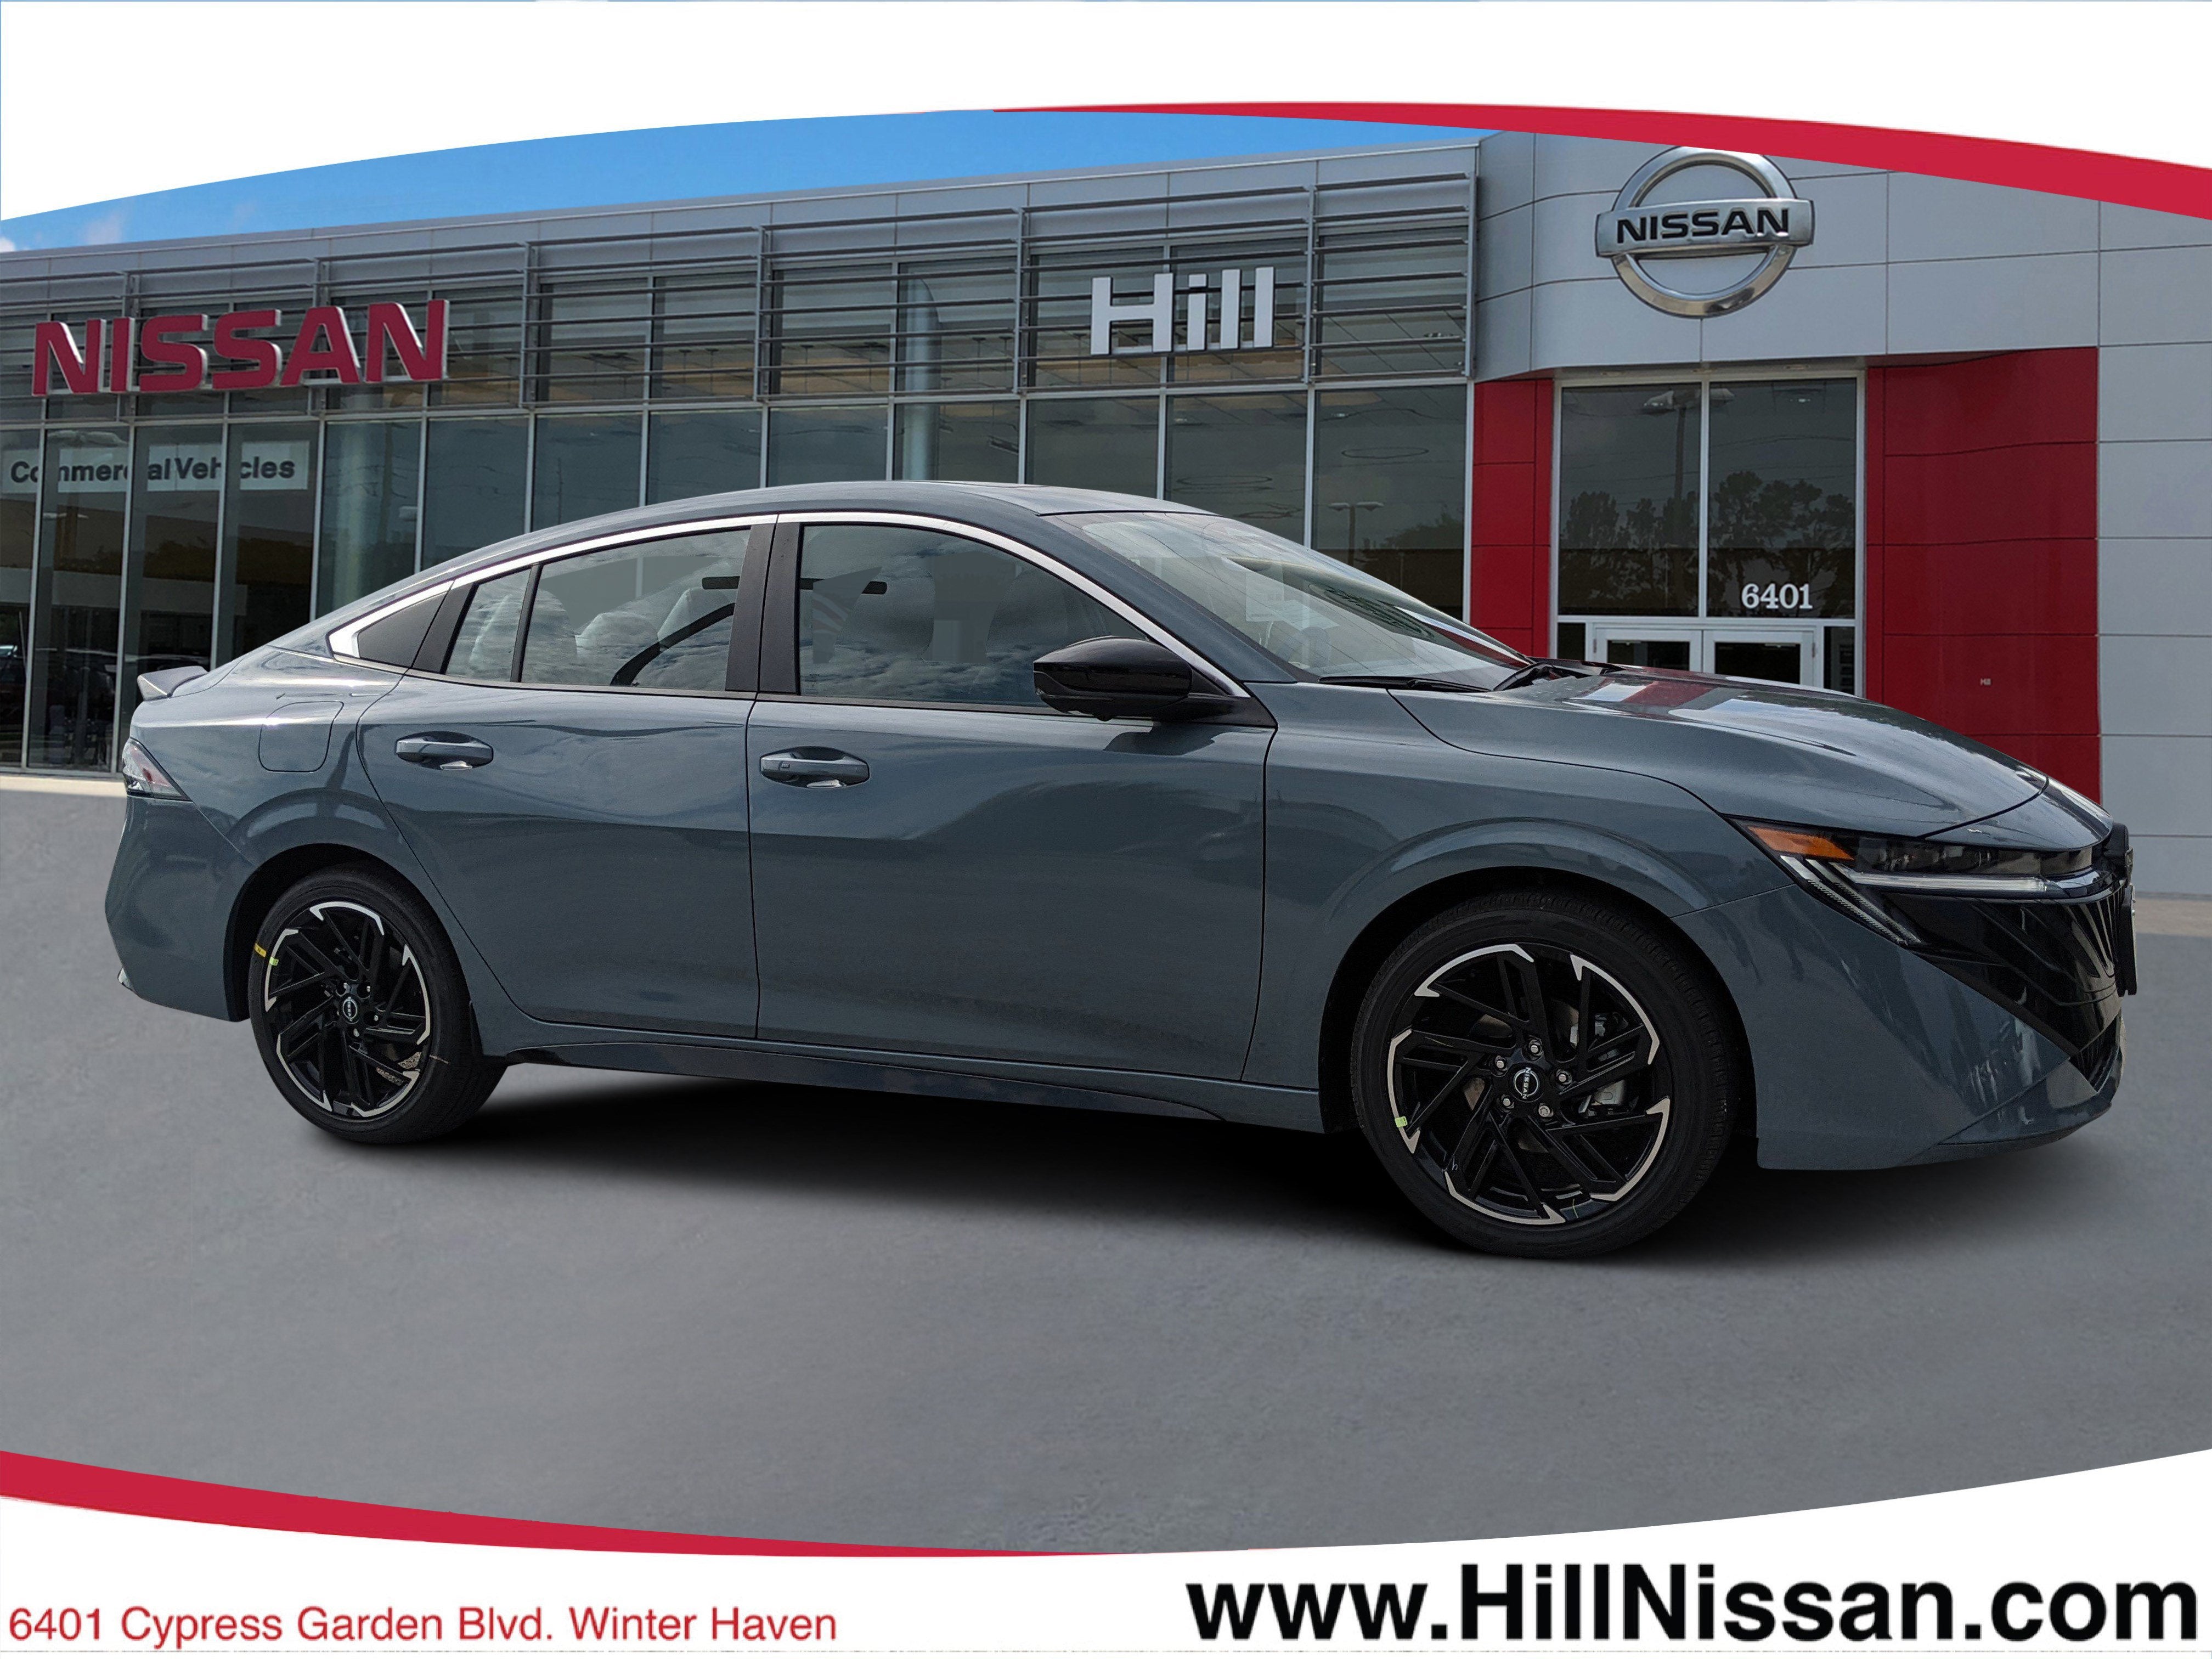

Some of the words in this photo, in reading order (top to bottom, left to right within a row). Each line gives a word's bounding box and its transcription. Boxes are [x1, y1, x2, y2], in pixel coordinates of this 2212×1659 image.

[1617, 208, 1789, 244] NISSAN
[1091, 266, 1276, 356] Hill
[32, 300, 449, 396] NISSAN
[1741, 583, 1813, 609] 6401
